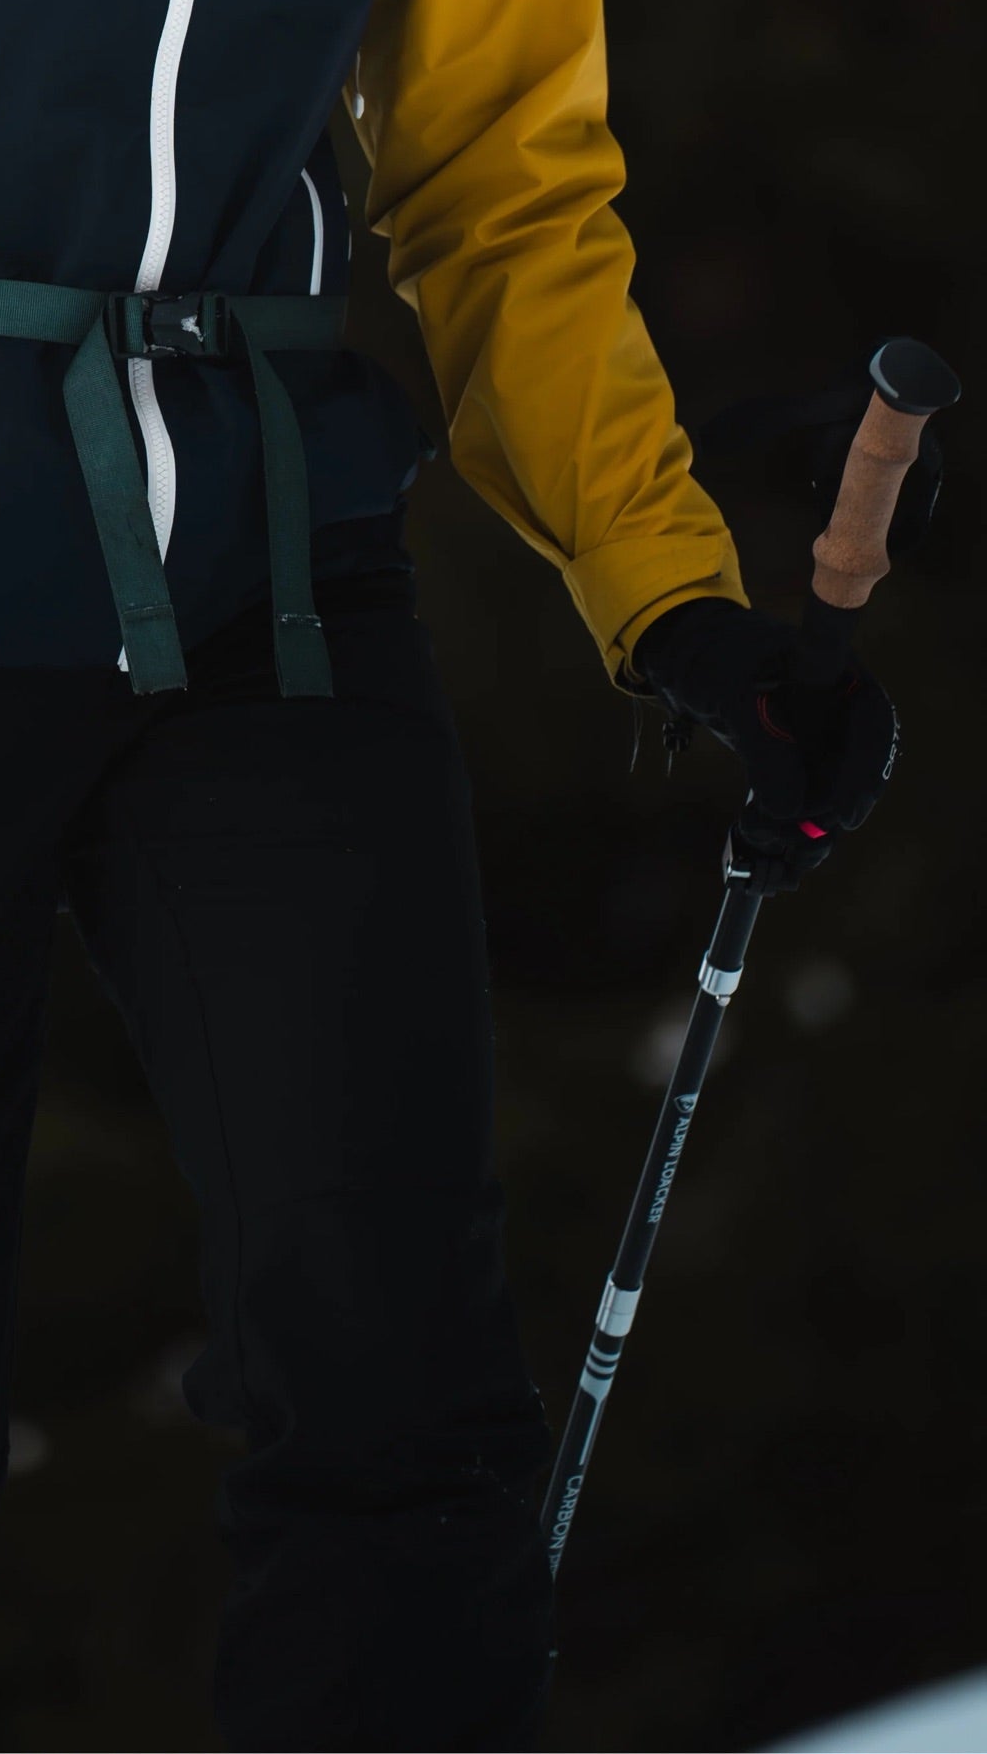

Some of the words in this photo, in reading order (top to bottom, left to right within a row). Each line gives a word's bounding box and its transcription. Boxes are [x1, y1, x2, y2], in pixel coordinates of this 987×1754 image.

[668, 1116, 691, 1157] ALPIN
[647, 1160, 678, 1223] LOACKER
[549, 1474, 584, 1549] CARBON
